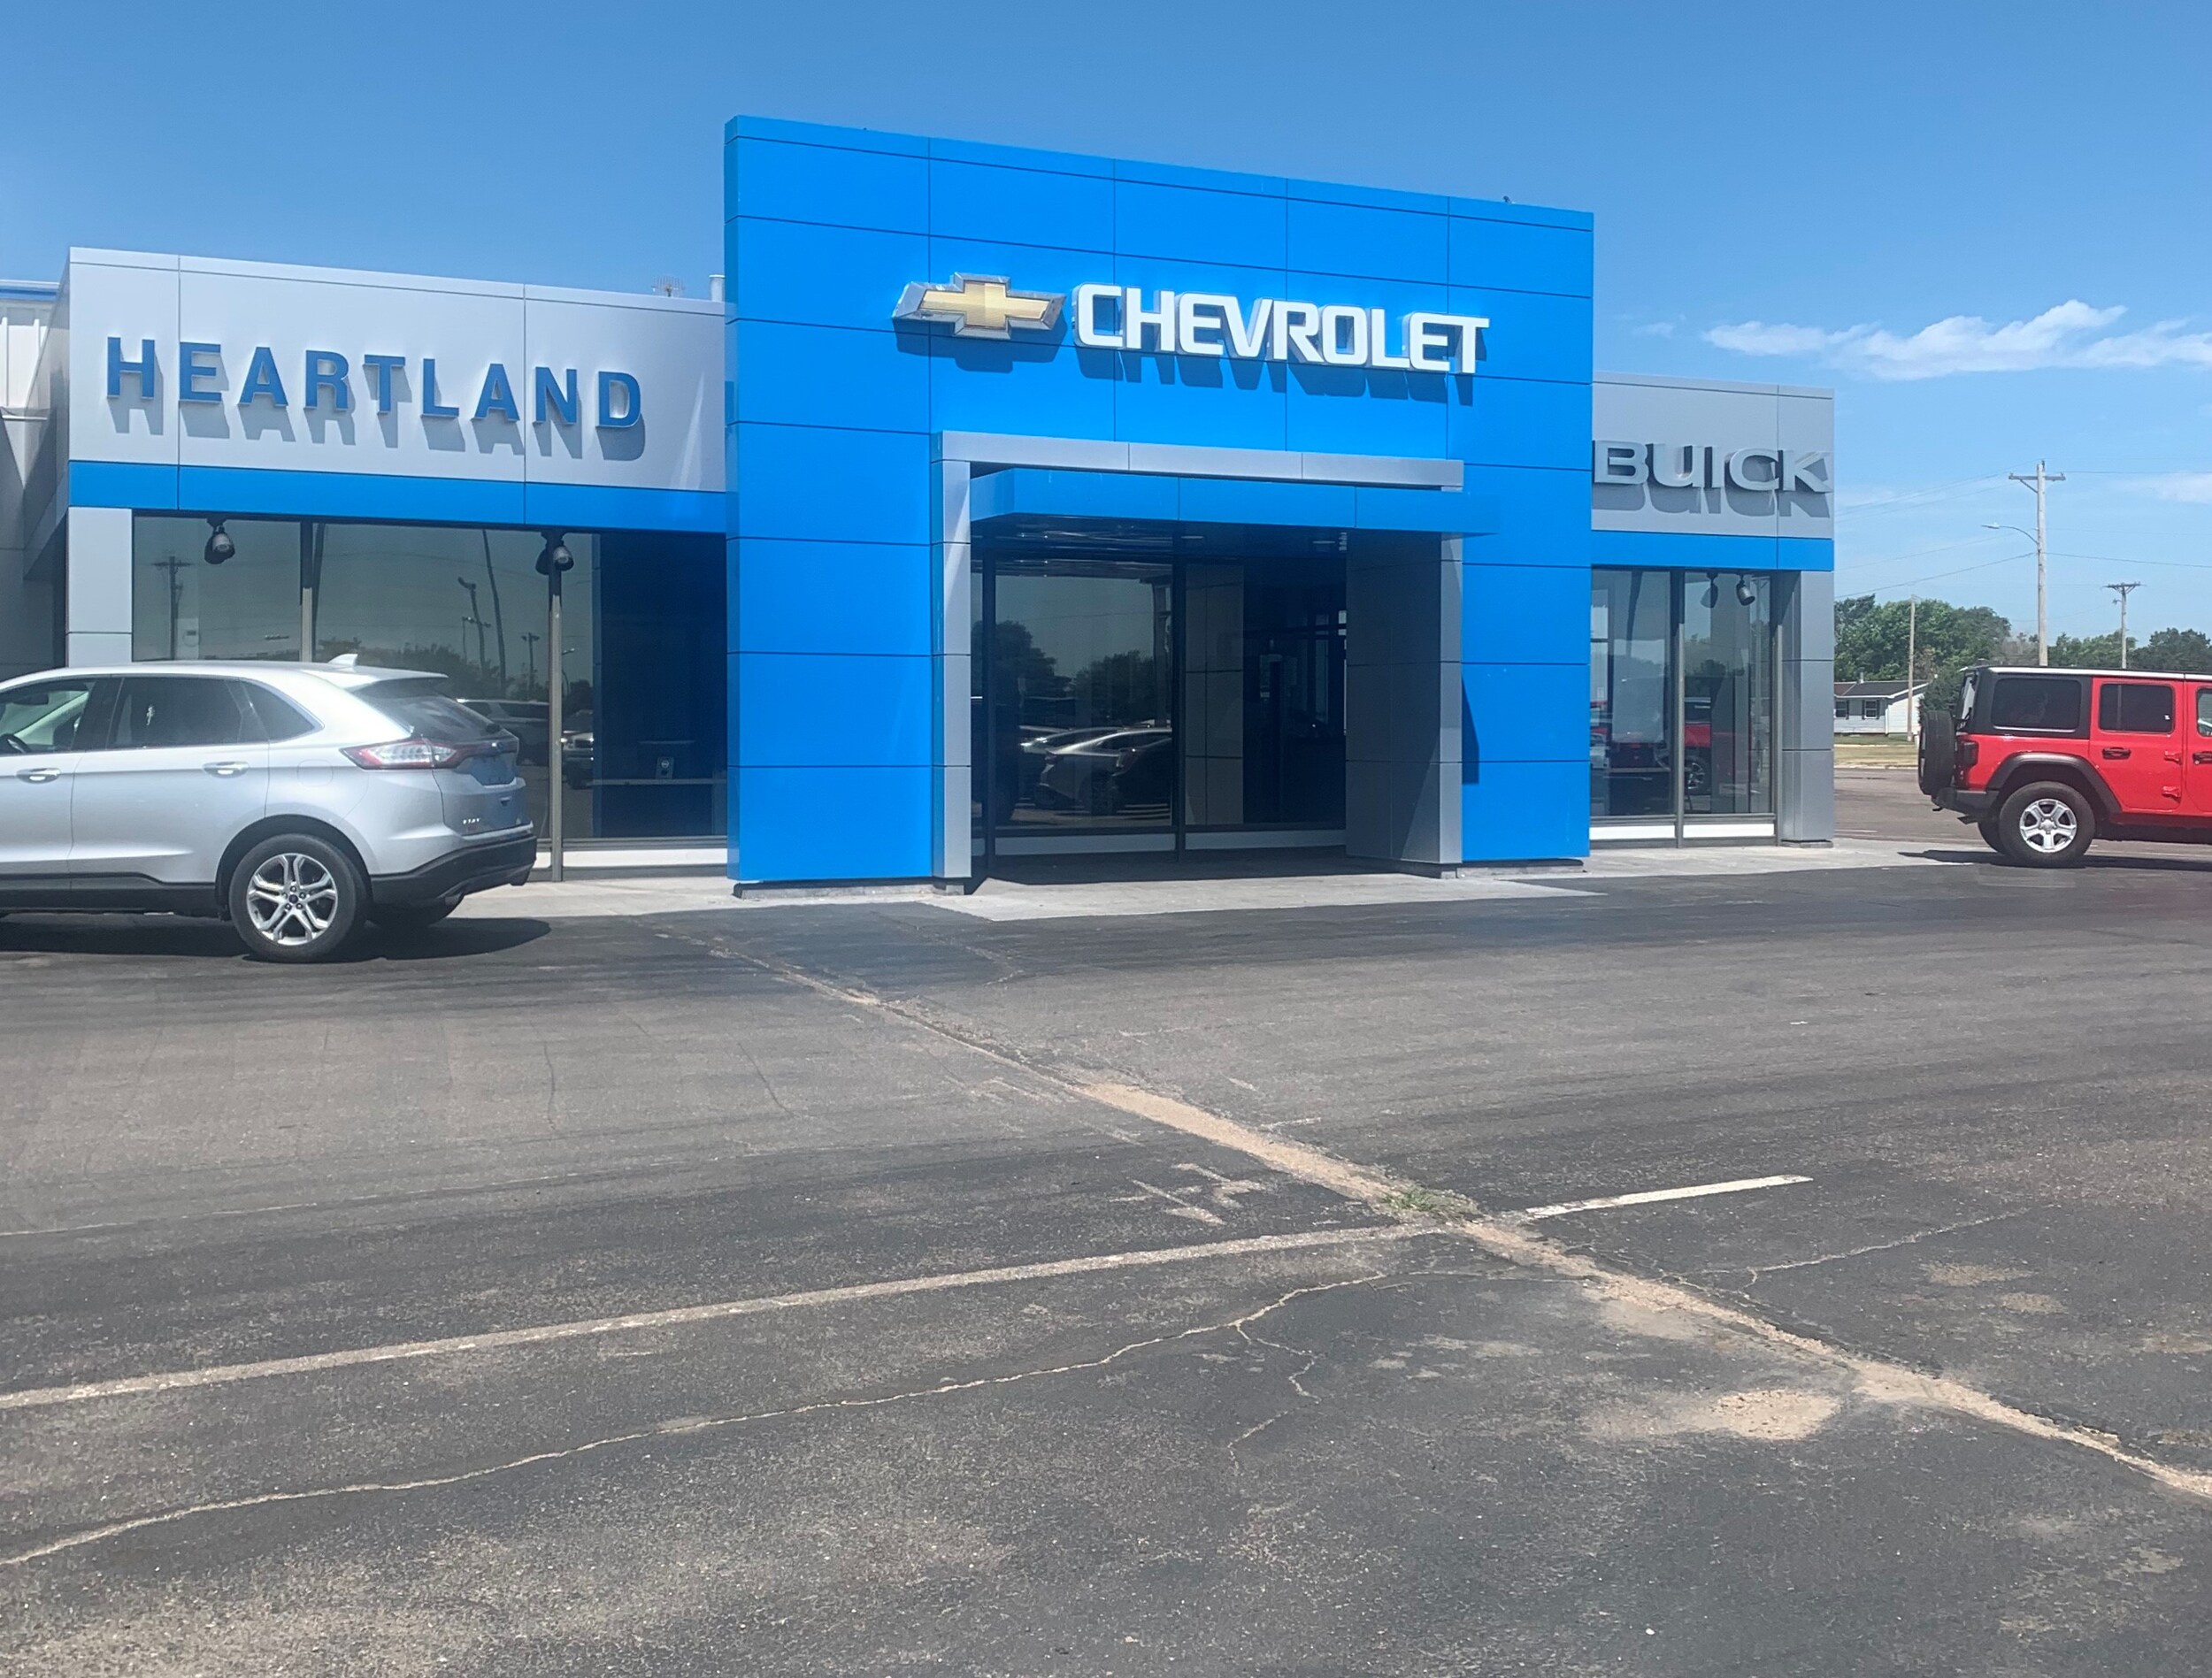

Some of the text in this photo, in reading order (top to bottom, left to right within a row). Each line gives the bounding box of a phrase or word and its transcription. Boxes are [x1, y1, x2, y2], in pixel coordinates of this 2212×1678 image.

[1074, 283, 1490, 373] CHEVROLET
[106, 336, 642, 428] HEARTLAND
[1593, 440, 1833, 493] BUICK
